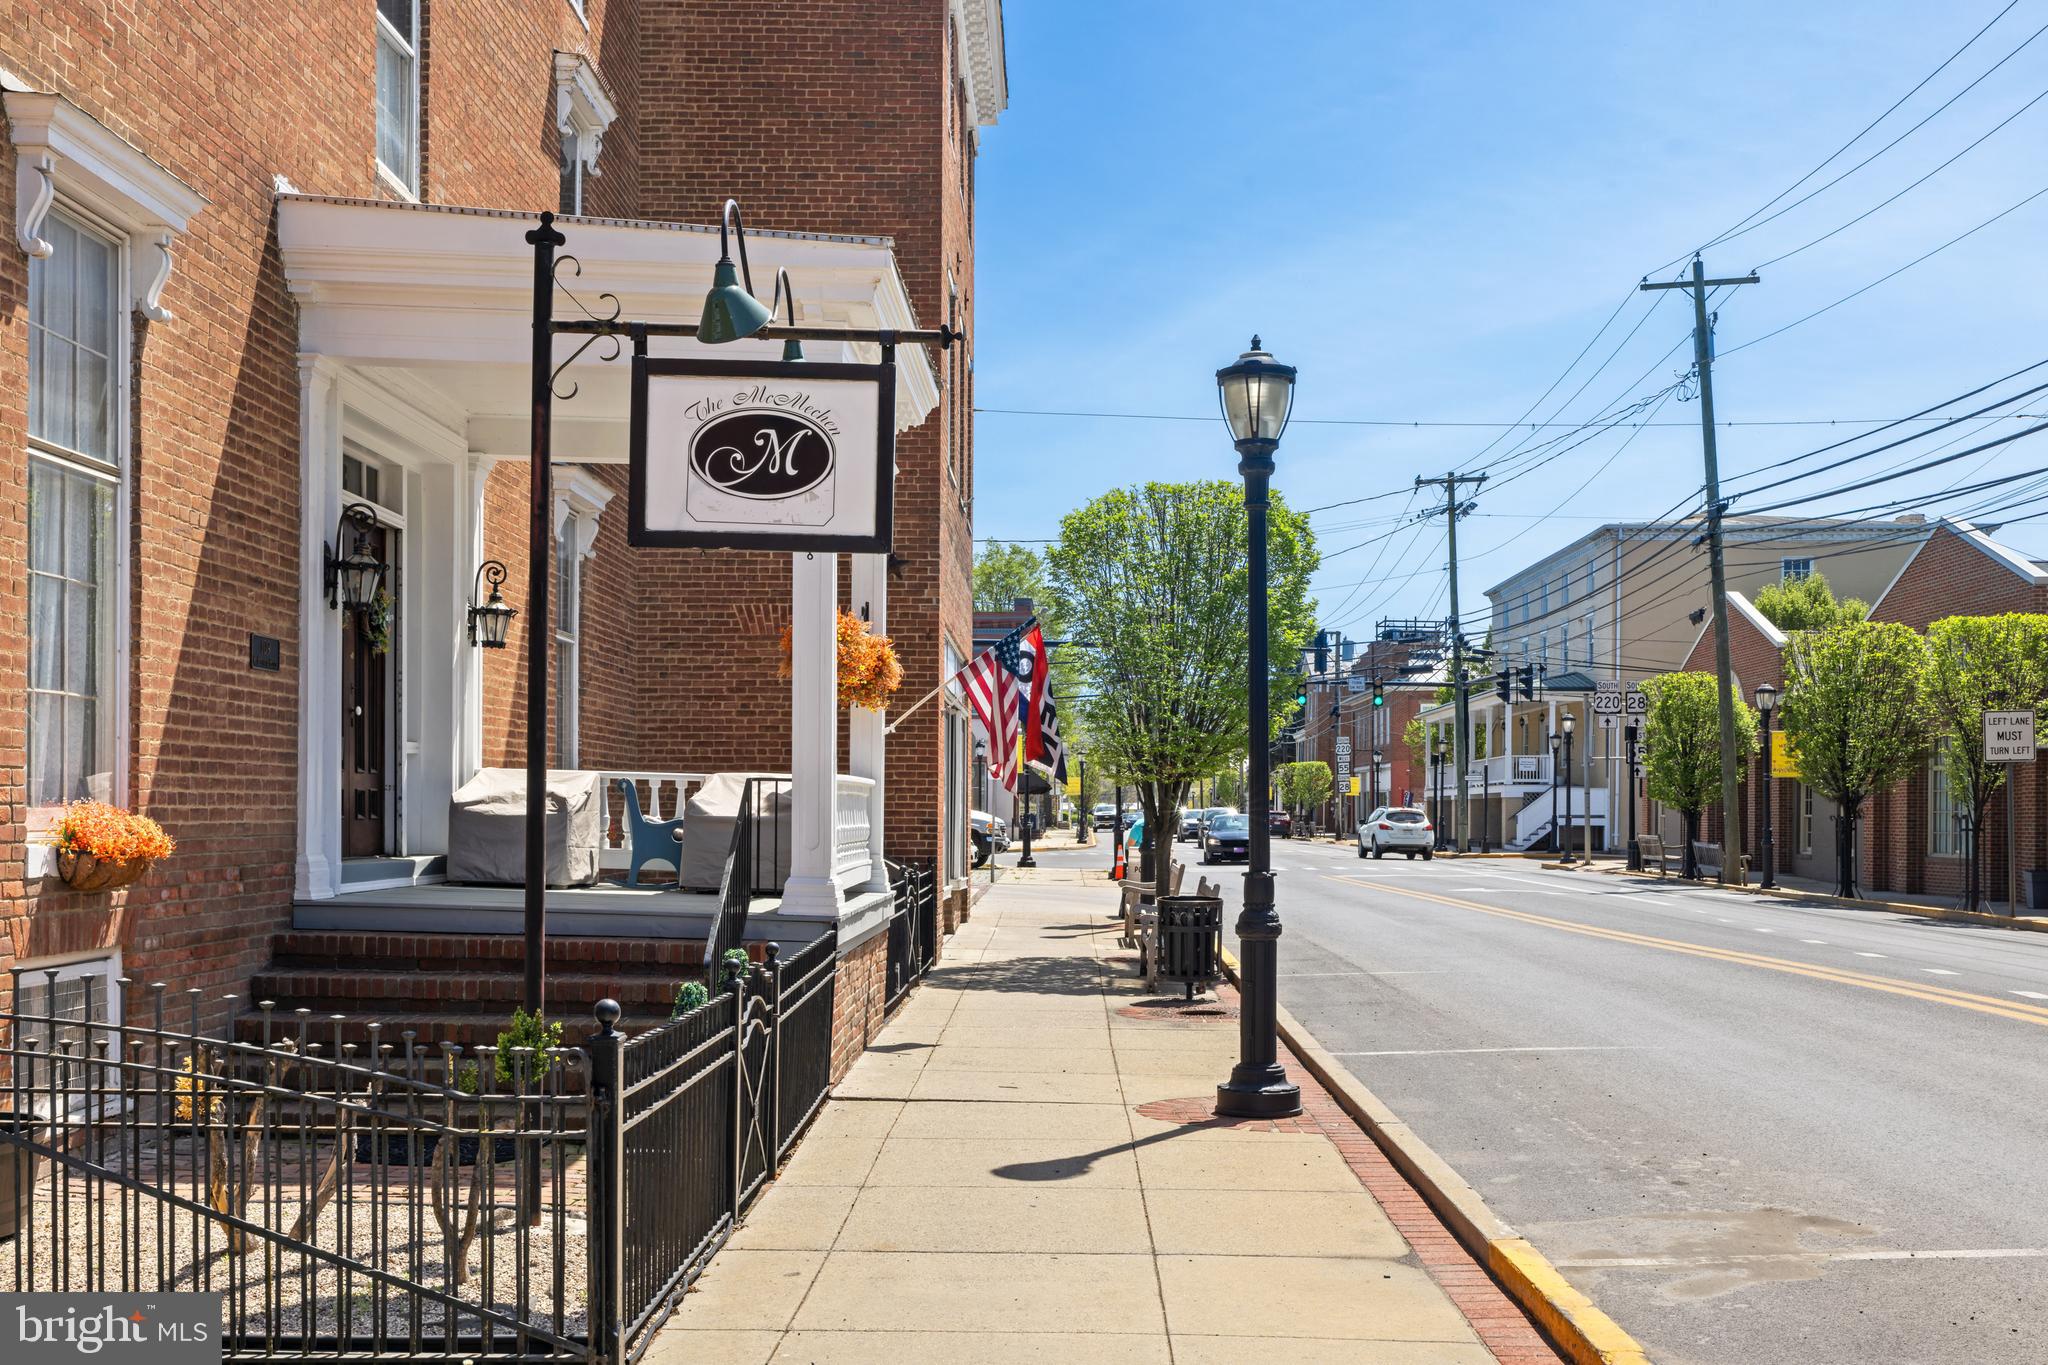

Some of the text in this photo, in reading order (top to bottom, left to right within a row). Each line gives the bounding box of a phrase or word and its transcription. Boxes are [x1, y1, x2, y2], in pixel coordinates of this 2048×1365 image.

[684, 384, 842, 437] The McMechen
[1598, 681, 1618, 690] SOUTH
[1596, 696, 1620, 709] 220
[1628, 696, 1646, 709] 28
[1988, 717, 2030, 726] LEFT LANE
[1996, 730, 2022, 741] MUST
[1336, 745, 1350, 753] 220
[1990, 746, 2031, 755] TURN LEFT
[1339, 764, 1349, 772] 55
[1340, 783, 1350, 791] 28
